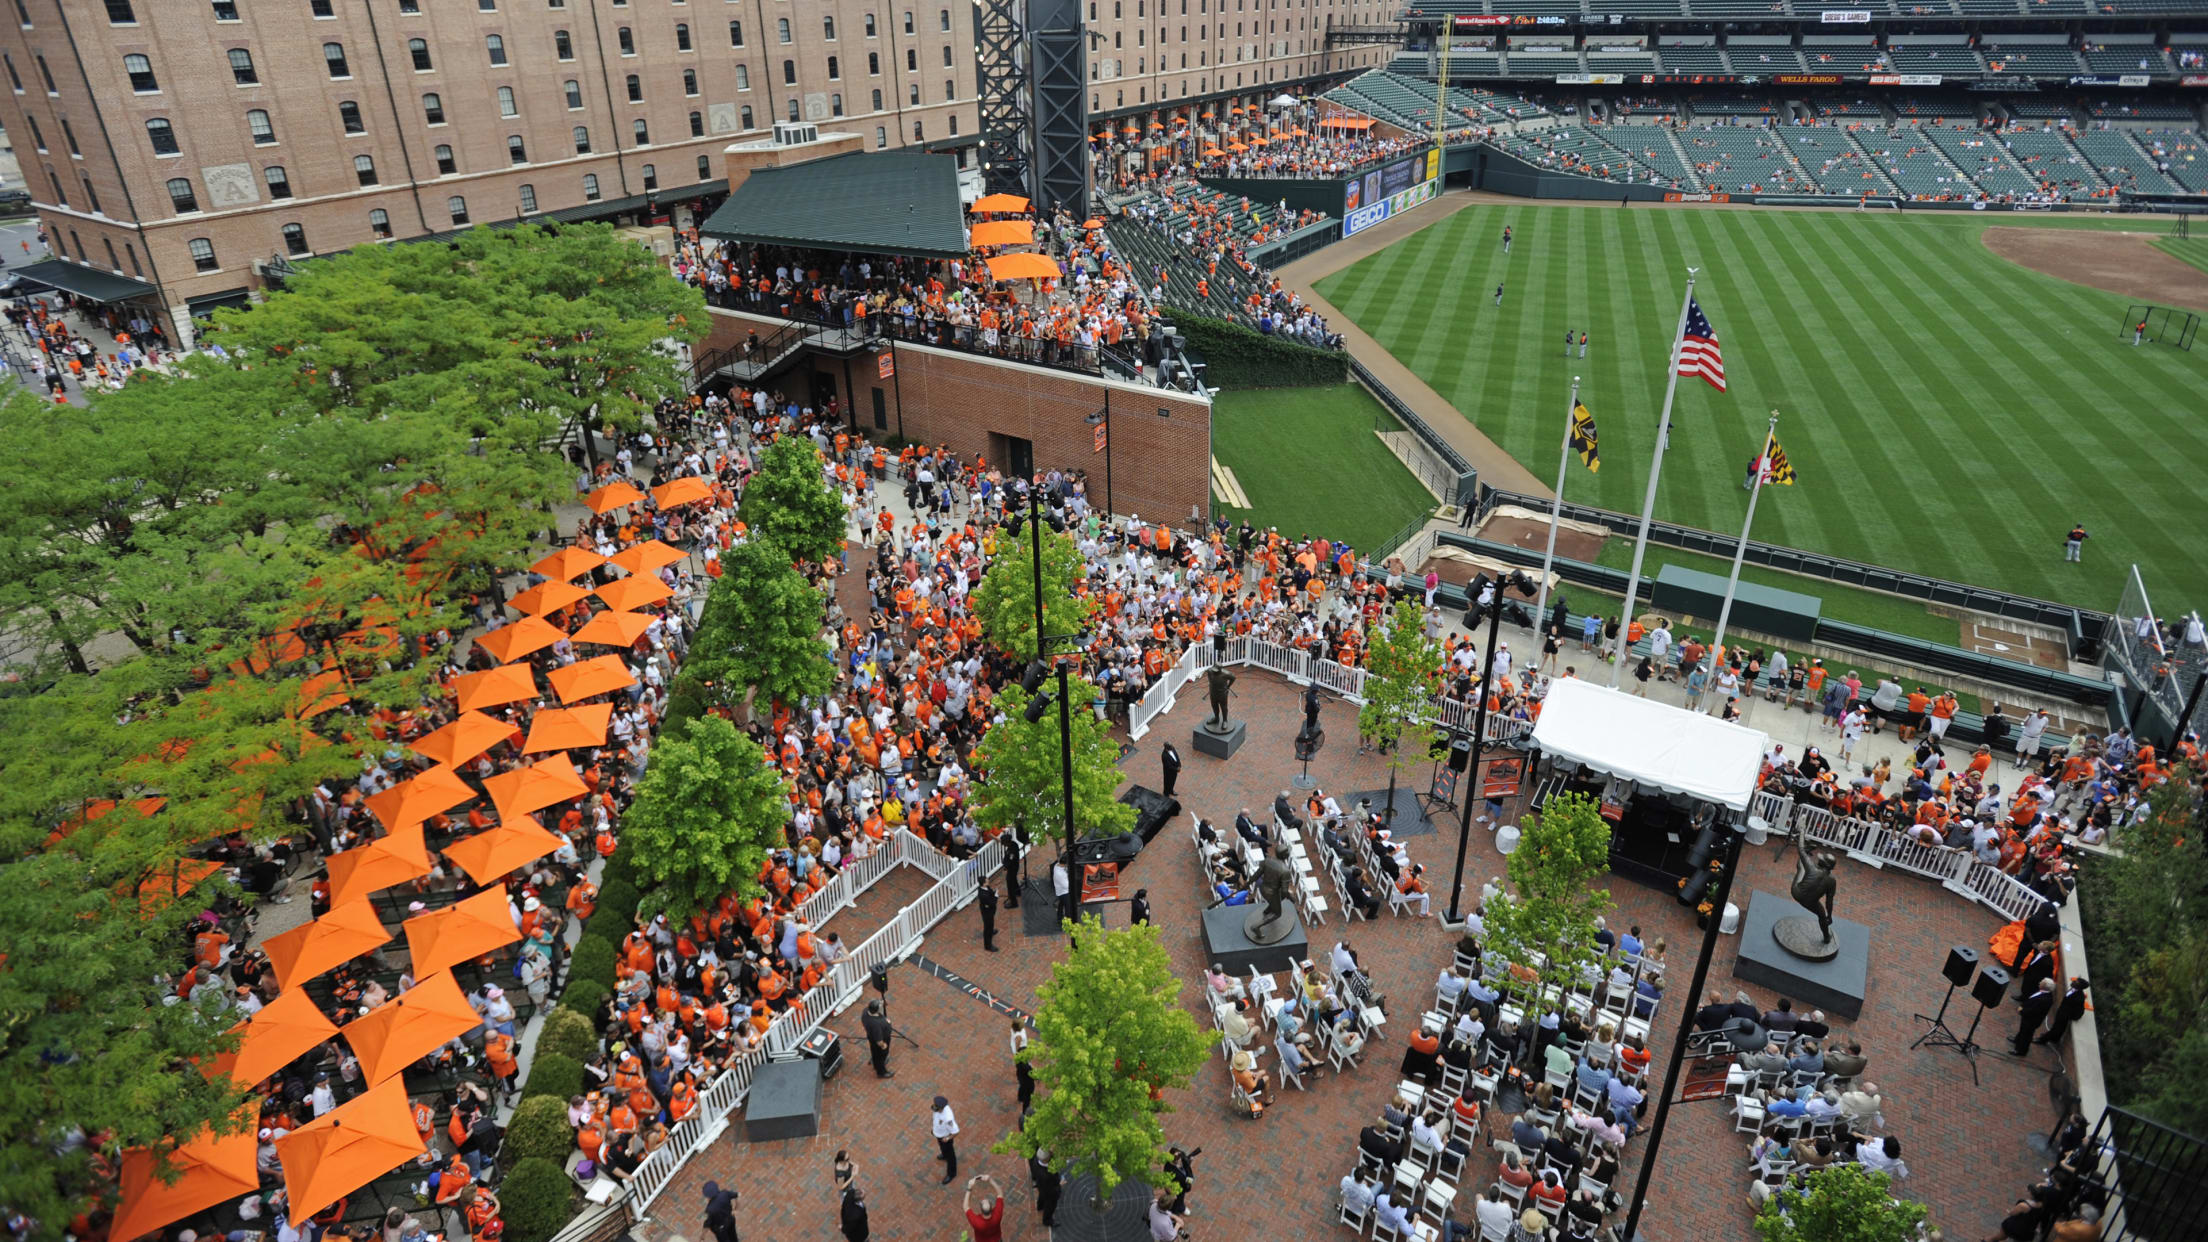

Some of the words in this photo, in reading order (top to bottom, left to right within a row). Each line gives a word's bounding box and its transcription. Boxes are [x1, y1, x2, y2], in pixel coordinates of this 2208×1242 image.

[1642, 75, 1654, 83] 22
[1780, 75, 1808, 83] WELLS
[1808, 75, 1837, 83] FARGO
[224, 181, 249, 201] A
[1350, 202, 1385, 232] GEICO
